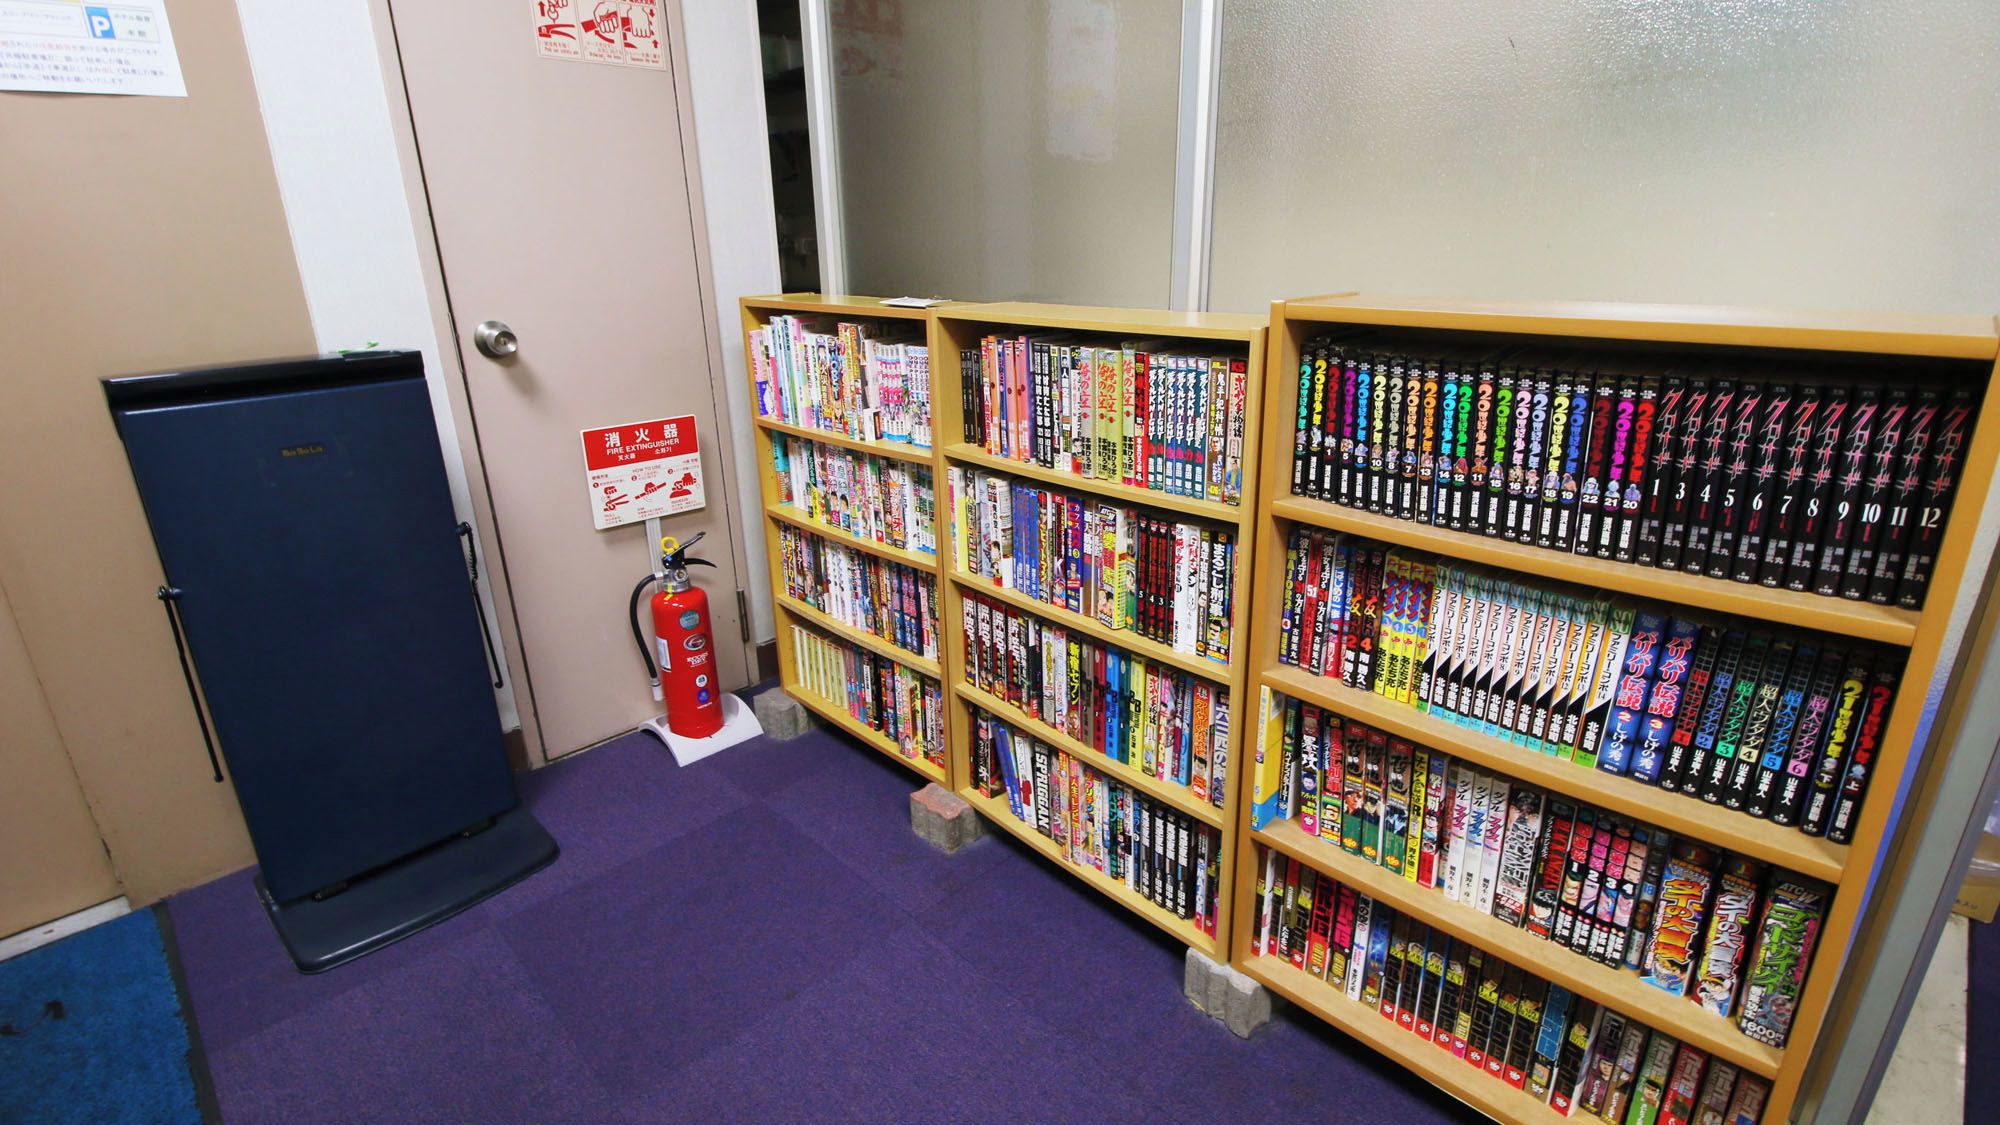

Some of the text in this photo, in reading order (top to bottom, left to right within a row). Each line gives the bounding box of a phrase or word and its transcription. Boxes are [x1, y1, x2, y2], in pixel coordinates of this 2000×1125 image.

[91, 16, 110, 37] P
[1215, 372, 1224, 436] 鬼平犯科帳
[607, 438, 679, 455] FIRE EXTINGUISHER
[1371, 459, 1382, 467] 10
[1420, 468, 1431, 476] 13
[1454, 474, 1465, 482] 12
[1473, 473, 1483, 481] 11
[1490, 479, 1501, 487] 15
[1509, 482, 1521, 490] 16
[1525, 486, 1536, 494] 17
[1652, 479, 1660, 496] 1
[1675, 482, 1686, 500] 3
[1544, 489, 1556, 497] 18
[1561, 491, 1573, 499] 19
[1583, 495, 1598, 503] 22
[1700, 485, 1711, 502] 4
[1724, 489, 1736, 507] 5
[1752, 492, 1763, 511] 6
[1604, 498, 1617, 507] 21
[1623, 501, 1638, 509] 20
[1779, 496, 1793, 515] 7
[1807, 498, 1820, 518] 8
[1838, 501, 1850, 521] 9
[1861, 503, 1881, 525] 10
[1890, 506, 1909, 527] 11
[1920, 507, 1942, 529] 12
[1150, 595, 1155, 603] 4
[1306, 585, 1318, 598] 51
[1159, 597, 1164, 605] 3
[1169, 600, 1174, 608] 2
[1294, 616, 1299, 625] 1
[1315, 624, 1322, 633] 3
[1347, 633, 1358, 648] 2
[1360, 637, 1372, 651] 4
[1616, 631, 1659, 710] バリバリ伝説
[1650, 634, 1694, 718] バリバリ伝説
[1680, 670, 1710, 730] 超人ウタダ
[1700, 672, 1732, 735] 超人ウタダ
[1721, 680, 1755, 744] 超人ウタダ
[1743, 684, 1779, 749] 超人ウタダ
[1767, 690, 1804, 755] 超人ウタダ
[1796, 696, 1830, 762] 超人ウタダ
[1608, 721, 1630, 766] しげの秀一
[1035, 753, 1051, 830] SPRIGGAN
[1456, 779, 1470, 800] ダブル
[1846, 780, 1859, 791] 上
[1473, 786, 1488, 807] ダブル
[1489, 791, 1506, 813] ダブル
[1571, 862, 1578, 872] 1
[1587, 870, 1599, 882] 2
[1605, 877, 1617, 889] 3
[1622, 883, 1634, 893] 4
[1779, 882, 1820, 906] ATCW
[1655, 879, 1708, 964] ダイの大冒険
[1708, 895, 1750, 979] ダイの大冒険
